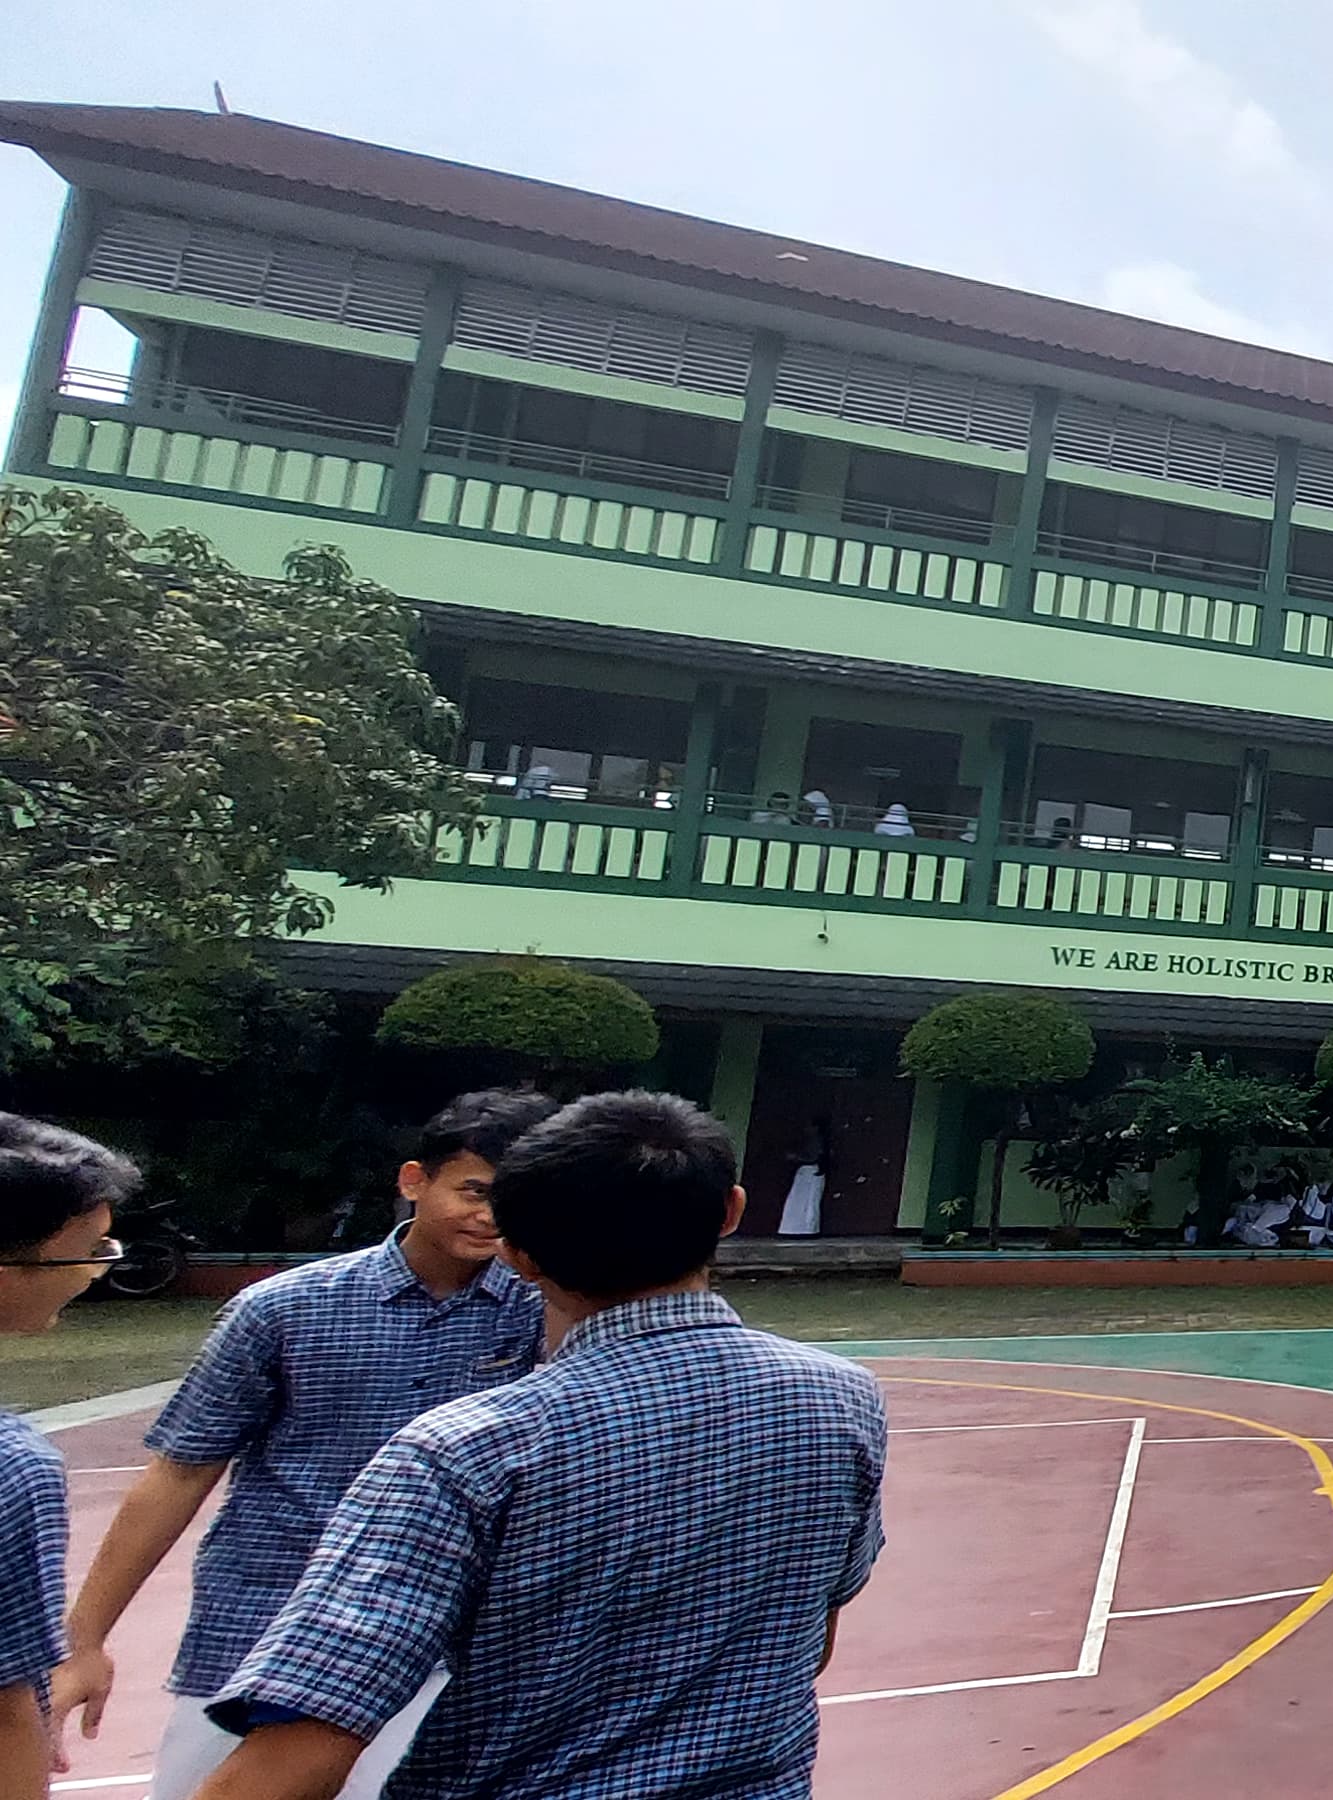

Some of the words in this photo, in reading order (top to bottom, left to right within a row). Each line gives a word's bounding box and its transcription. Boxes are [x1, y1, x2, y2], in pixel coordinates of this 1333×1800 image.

[1051, 946, 1096, 969] WE
[1104, 951, 1159, 972] ARE
[1167, 954, 1295, 983] HOLISTIC
